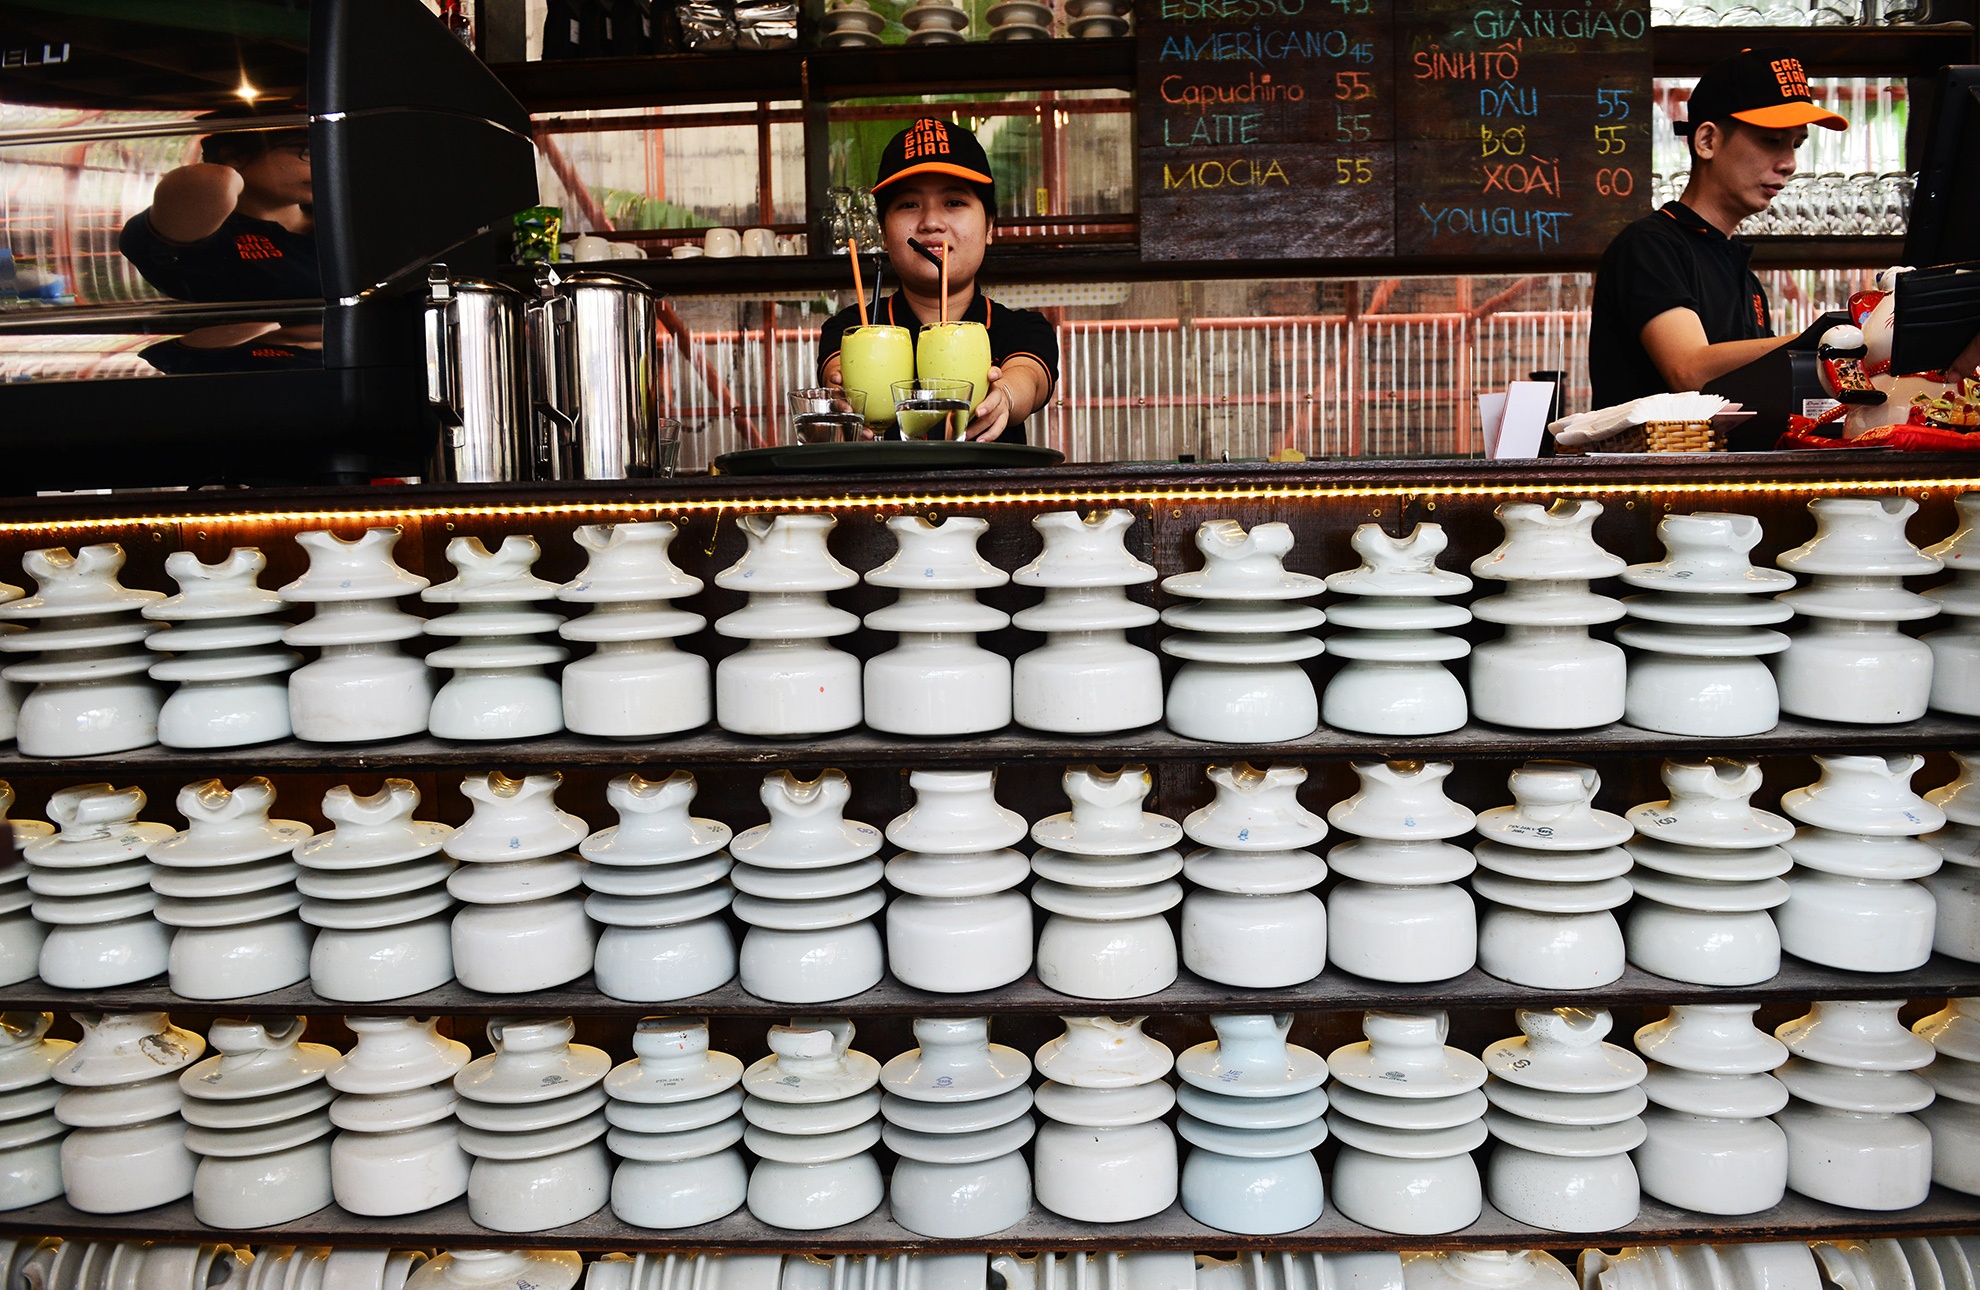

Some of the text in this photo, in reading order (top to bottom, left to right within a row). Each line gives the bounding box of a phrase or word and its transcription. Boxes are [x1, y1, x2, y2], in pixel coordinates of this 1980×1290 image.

[1350, 43, 1375, 64] 45
[1771, 58, 1803, 72] CAFE
[1160, 71, 1370, 114] Capuchino 55
[1776, 71, 1808, 84] GIAN
[1597, 87, 1632, 120] 55
[905, 131, 948, 148] GIAN
[1164, 113, 1371, 147] LATTE 55
[1594, 124, 1628, 155] 55
[905, 142, 950, 159] GIAO
[1163, 157, 1373, 189] MOCHA 55
[1596, 167, 1633, 196] 60
[1419, 204, 1573, 251] YOUGURT
